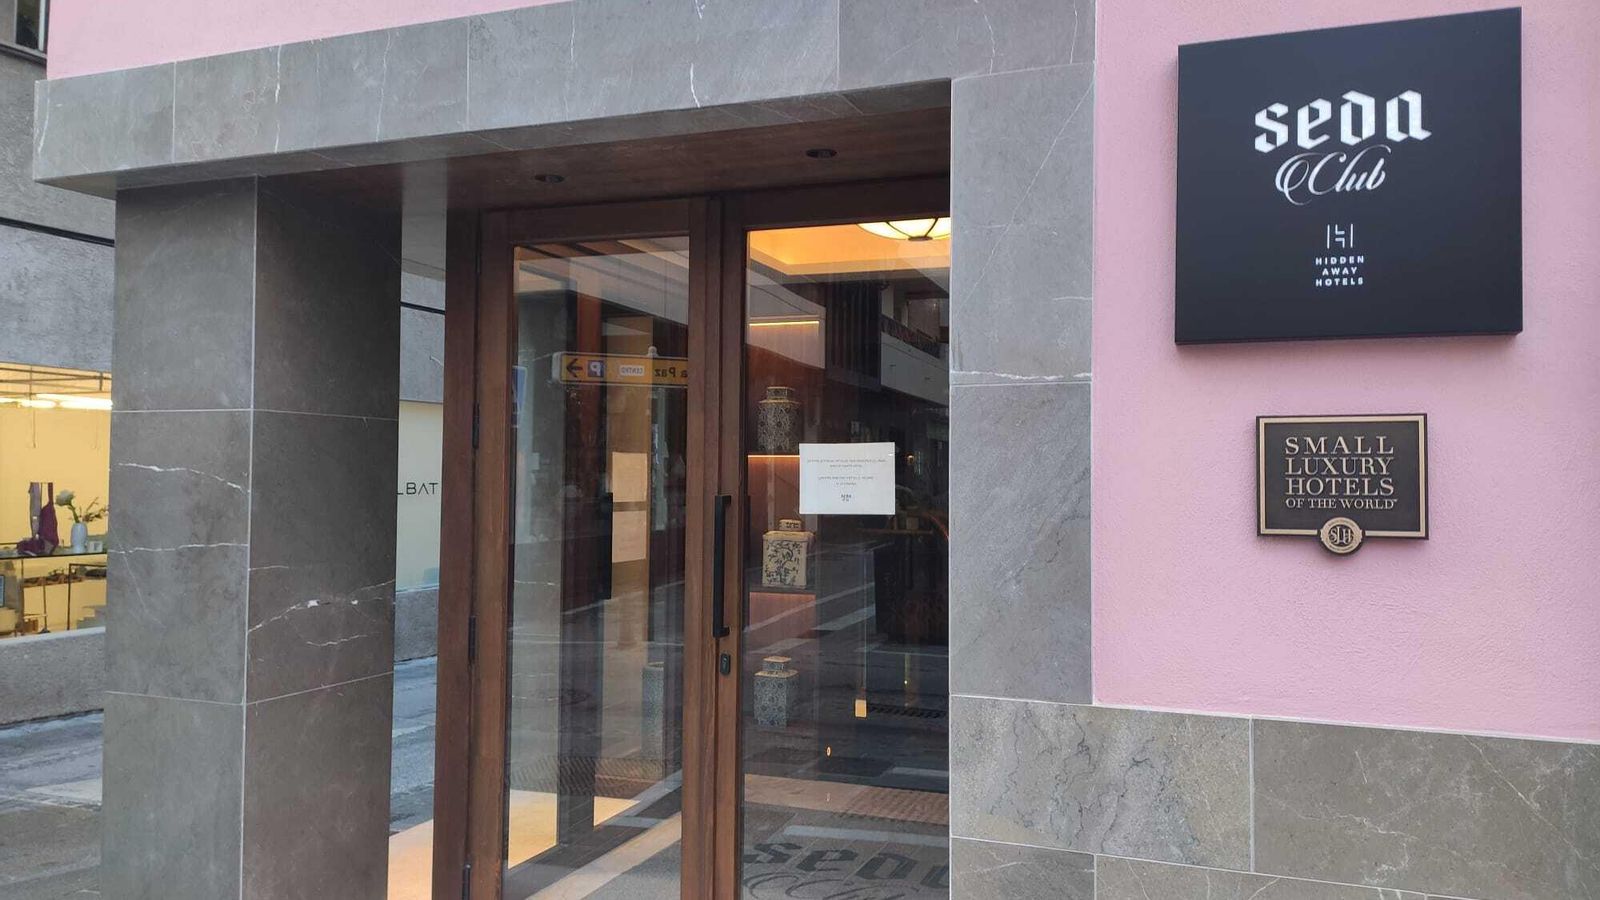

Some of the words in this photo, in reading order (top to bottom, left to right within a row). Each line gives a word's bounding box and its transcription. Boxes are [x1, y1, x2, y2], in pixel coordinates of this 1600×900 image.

[1254, 90, 1432, 153] seda
[1275, 144, 1391, 205] Club
[1315, 256, 1364, 266] HIDDEN
[1322, 267, 1357, 276] AWAY
[1315, 277, 1364, 287] HOTELS
[1285, 436, 1394, 455] SMALL
[1285, 457, 1394, 475] LUXURY
[1285, 478, 1394, 496] HOTELS
[1286, 498, 1304, 508] OF
[1308, 499, 1337, 509] THE
